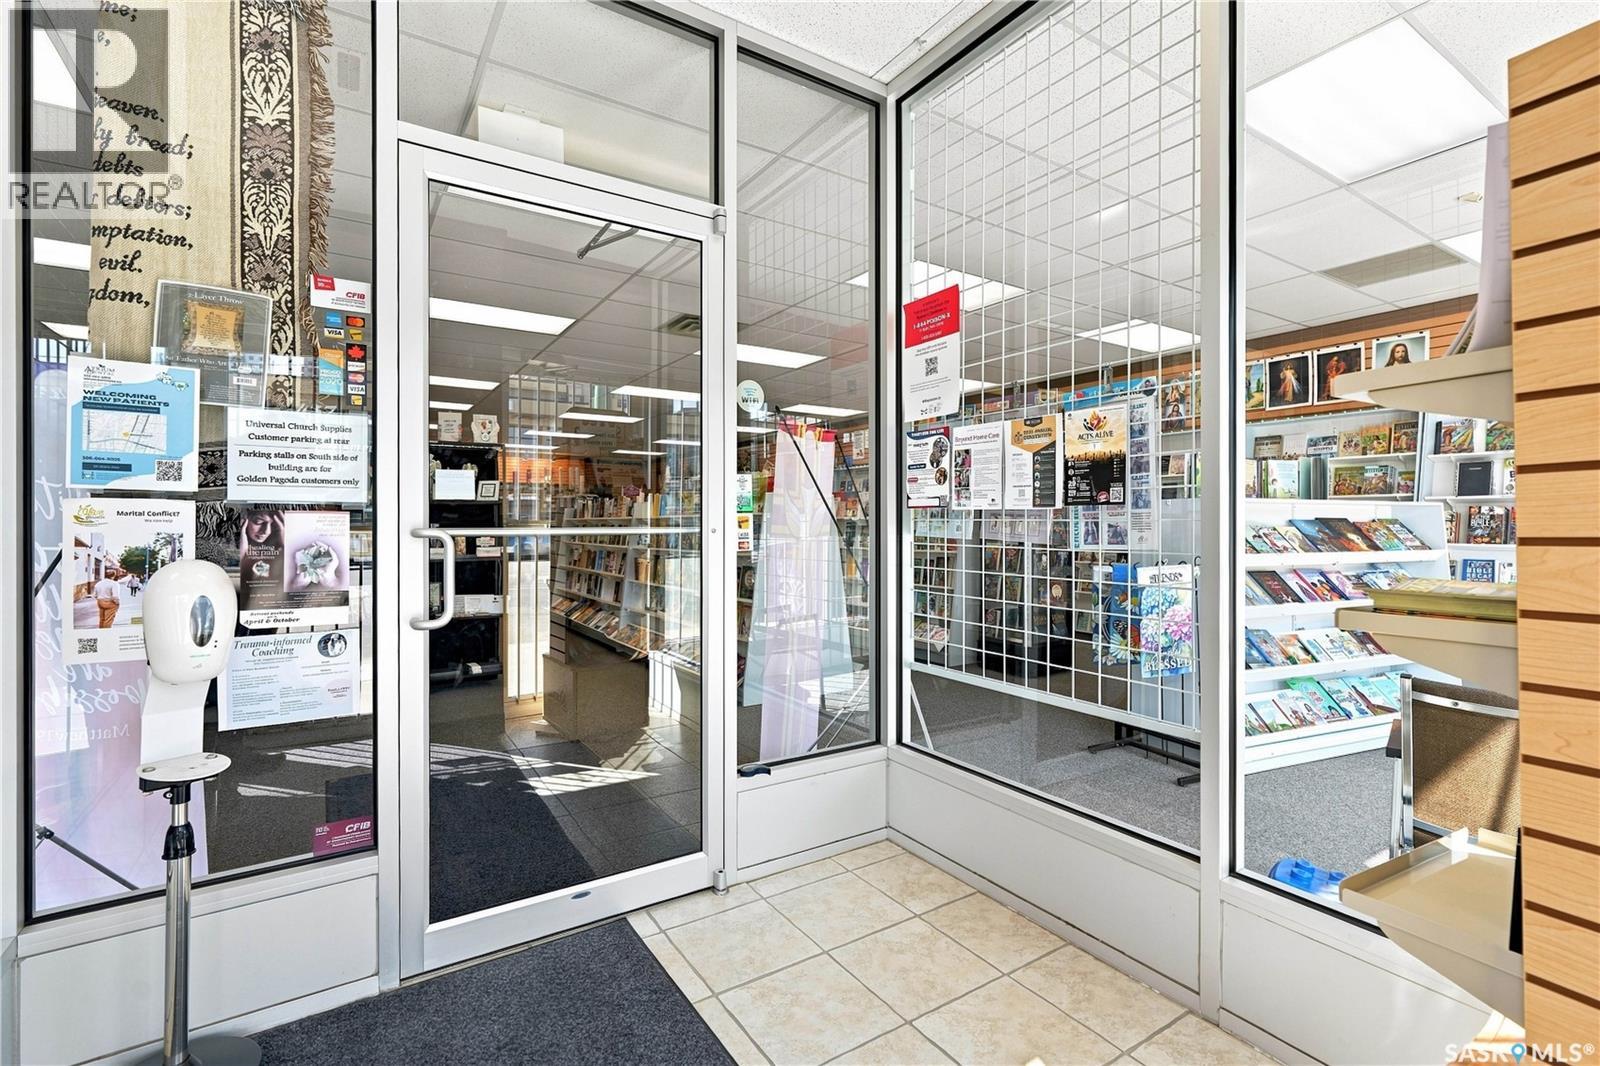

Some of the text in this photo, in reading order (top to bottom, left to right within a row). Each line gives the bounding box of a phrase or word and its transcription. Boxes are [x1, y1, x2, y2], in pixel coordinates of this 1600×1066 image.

[126, 124, 195, 160] bread;
[107, 183, 192, 220] debtors;
[98, 250, 143, 273] evil.
[345, 291, 366, 301] CFIB
[327, 329, 343, 337] VISA
[350, 384, 365, 393] VISA
[83, 389, 157, 401] WELCOMING
[113, 398, 170, 407] PATIENTS
[245, 420, 353, 434] Universal Church Supplies
[248, 433, 289, 442] Customer
[290, 434, 323, 445] parking
[1077, 430, 1115, 441] ACTS ALIVE
[238, 450, 272, 460] Parking
[273, 450, 295, 459] stalls
[308, 452, 332, 461] South
[333, 454, 349, 462] side
[268, 463, 304, 473] building
[319, 465, 333, 473] for
[236, 474, 360, 487] Golden Pagoda customers only
[233, 636, 313, 650] Trauma-informed
[251, 647, 295, 658] Coaching
[345, 821, 371, 833] CFIB
